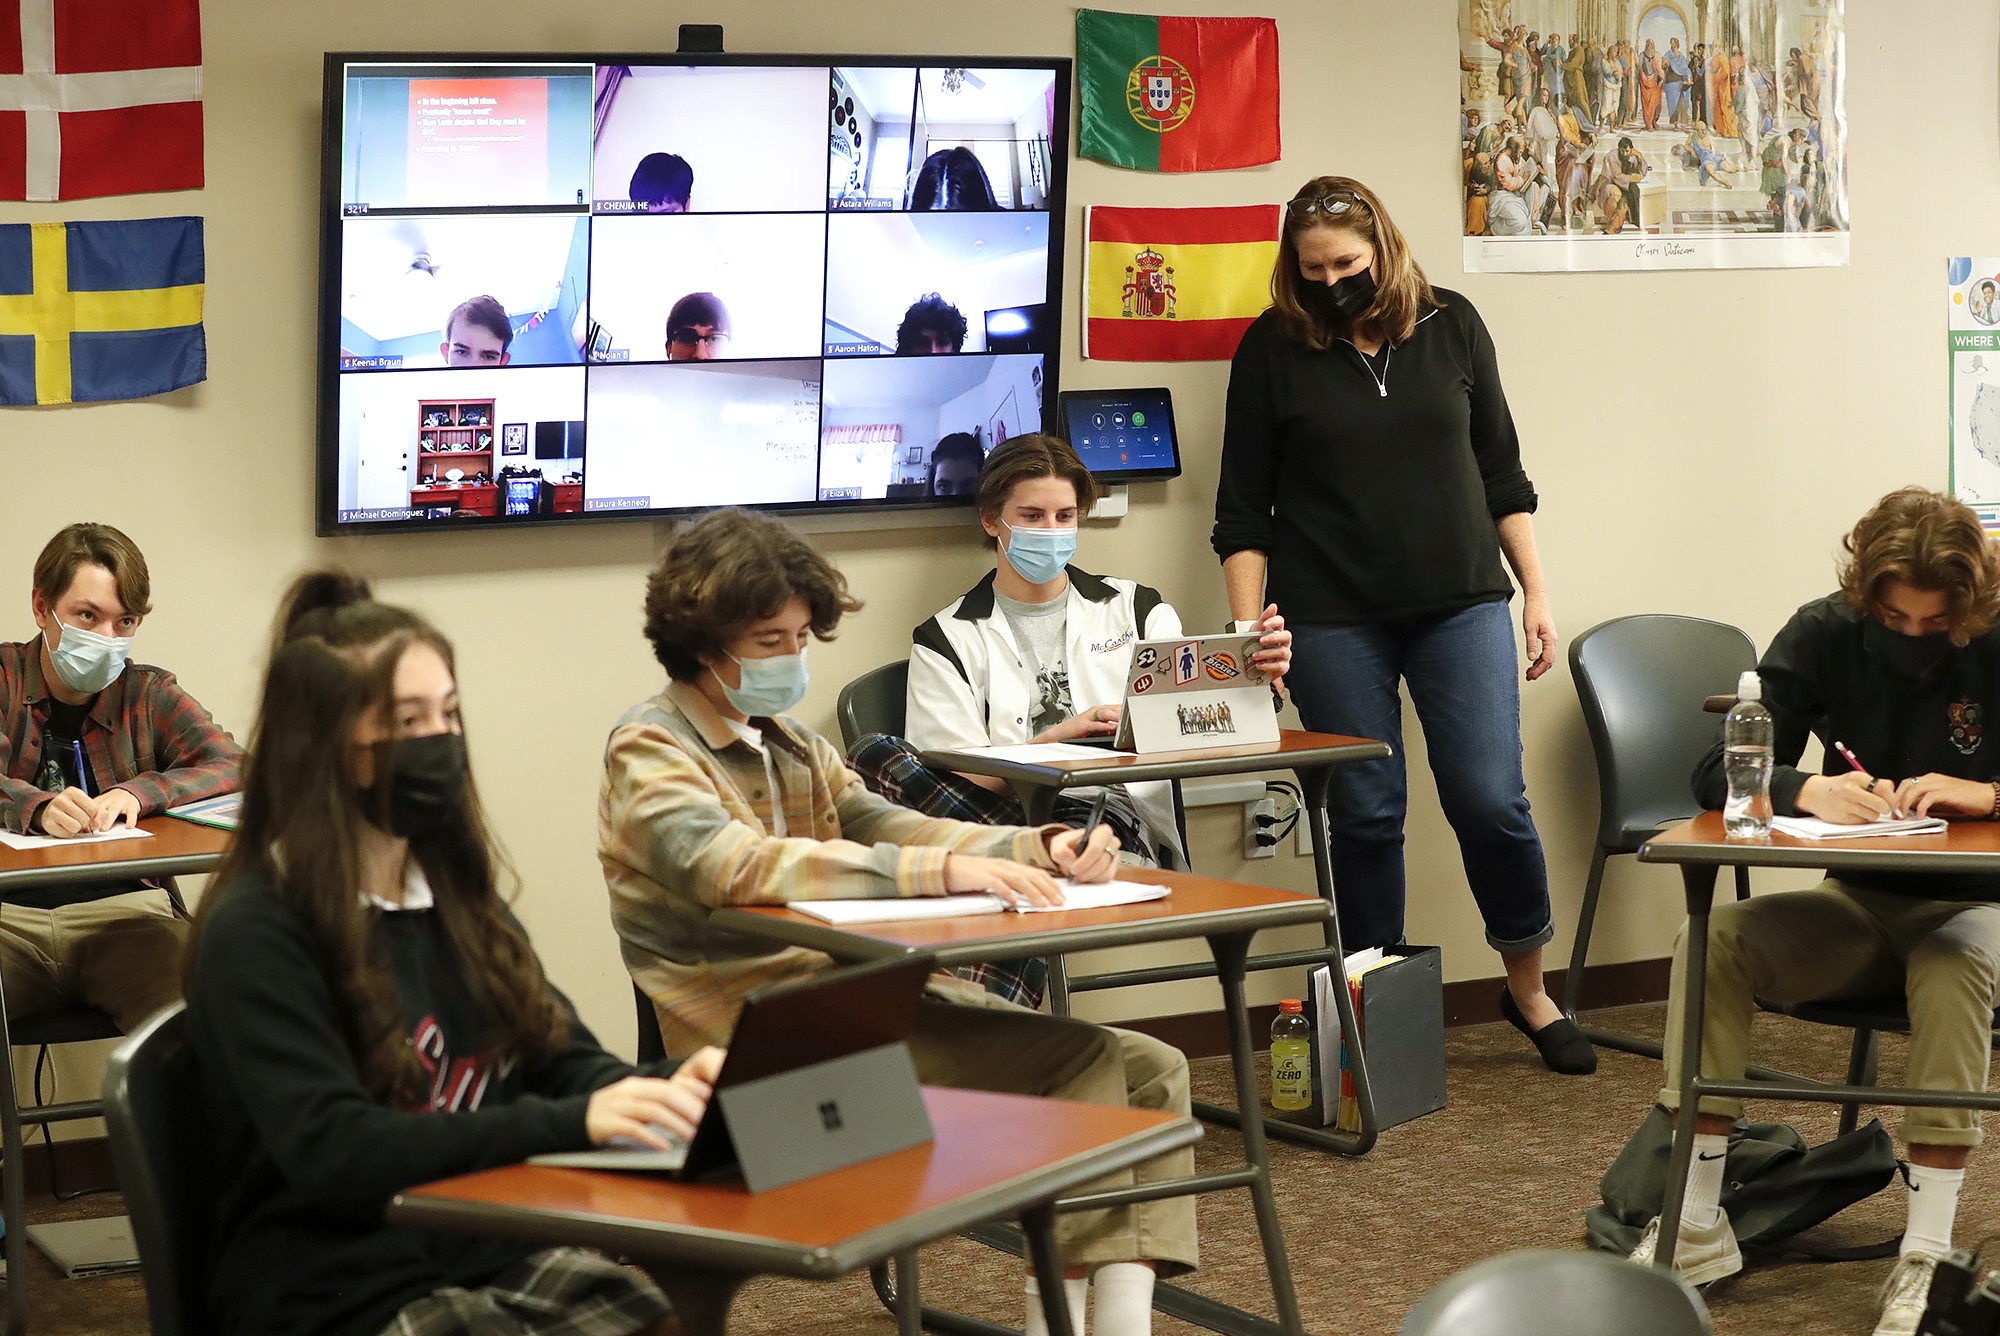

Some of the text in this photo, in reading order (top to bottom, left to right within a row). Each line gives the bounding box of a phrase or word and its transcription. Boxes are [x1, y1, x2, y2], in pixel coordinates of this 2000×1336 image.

[347, 205, 368, 214] 3214
[603, 201, 648, 210] CHENJIA HE
[1954, 335, 1994, 347] WHERE
[834, 344, 856, 353] Aaron
[623, 350, 629, 359] B
[352, 357, 402, 367] Keenai Braun
[595, 498, 649, 508] Laura Kennedy
[350, 509, 424, 520] Michael Dominguez
[1204, 656, 1237, 678] Dickies
[1276, 1070, 1302, 1080] ZERO
